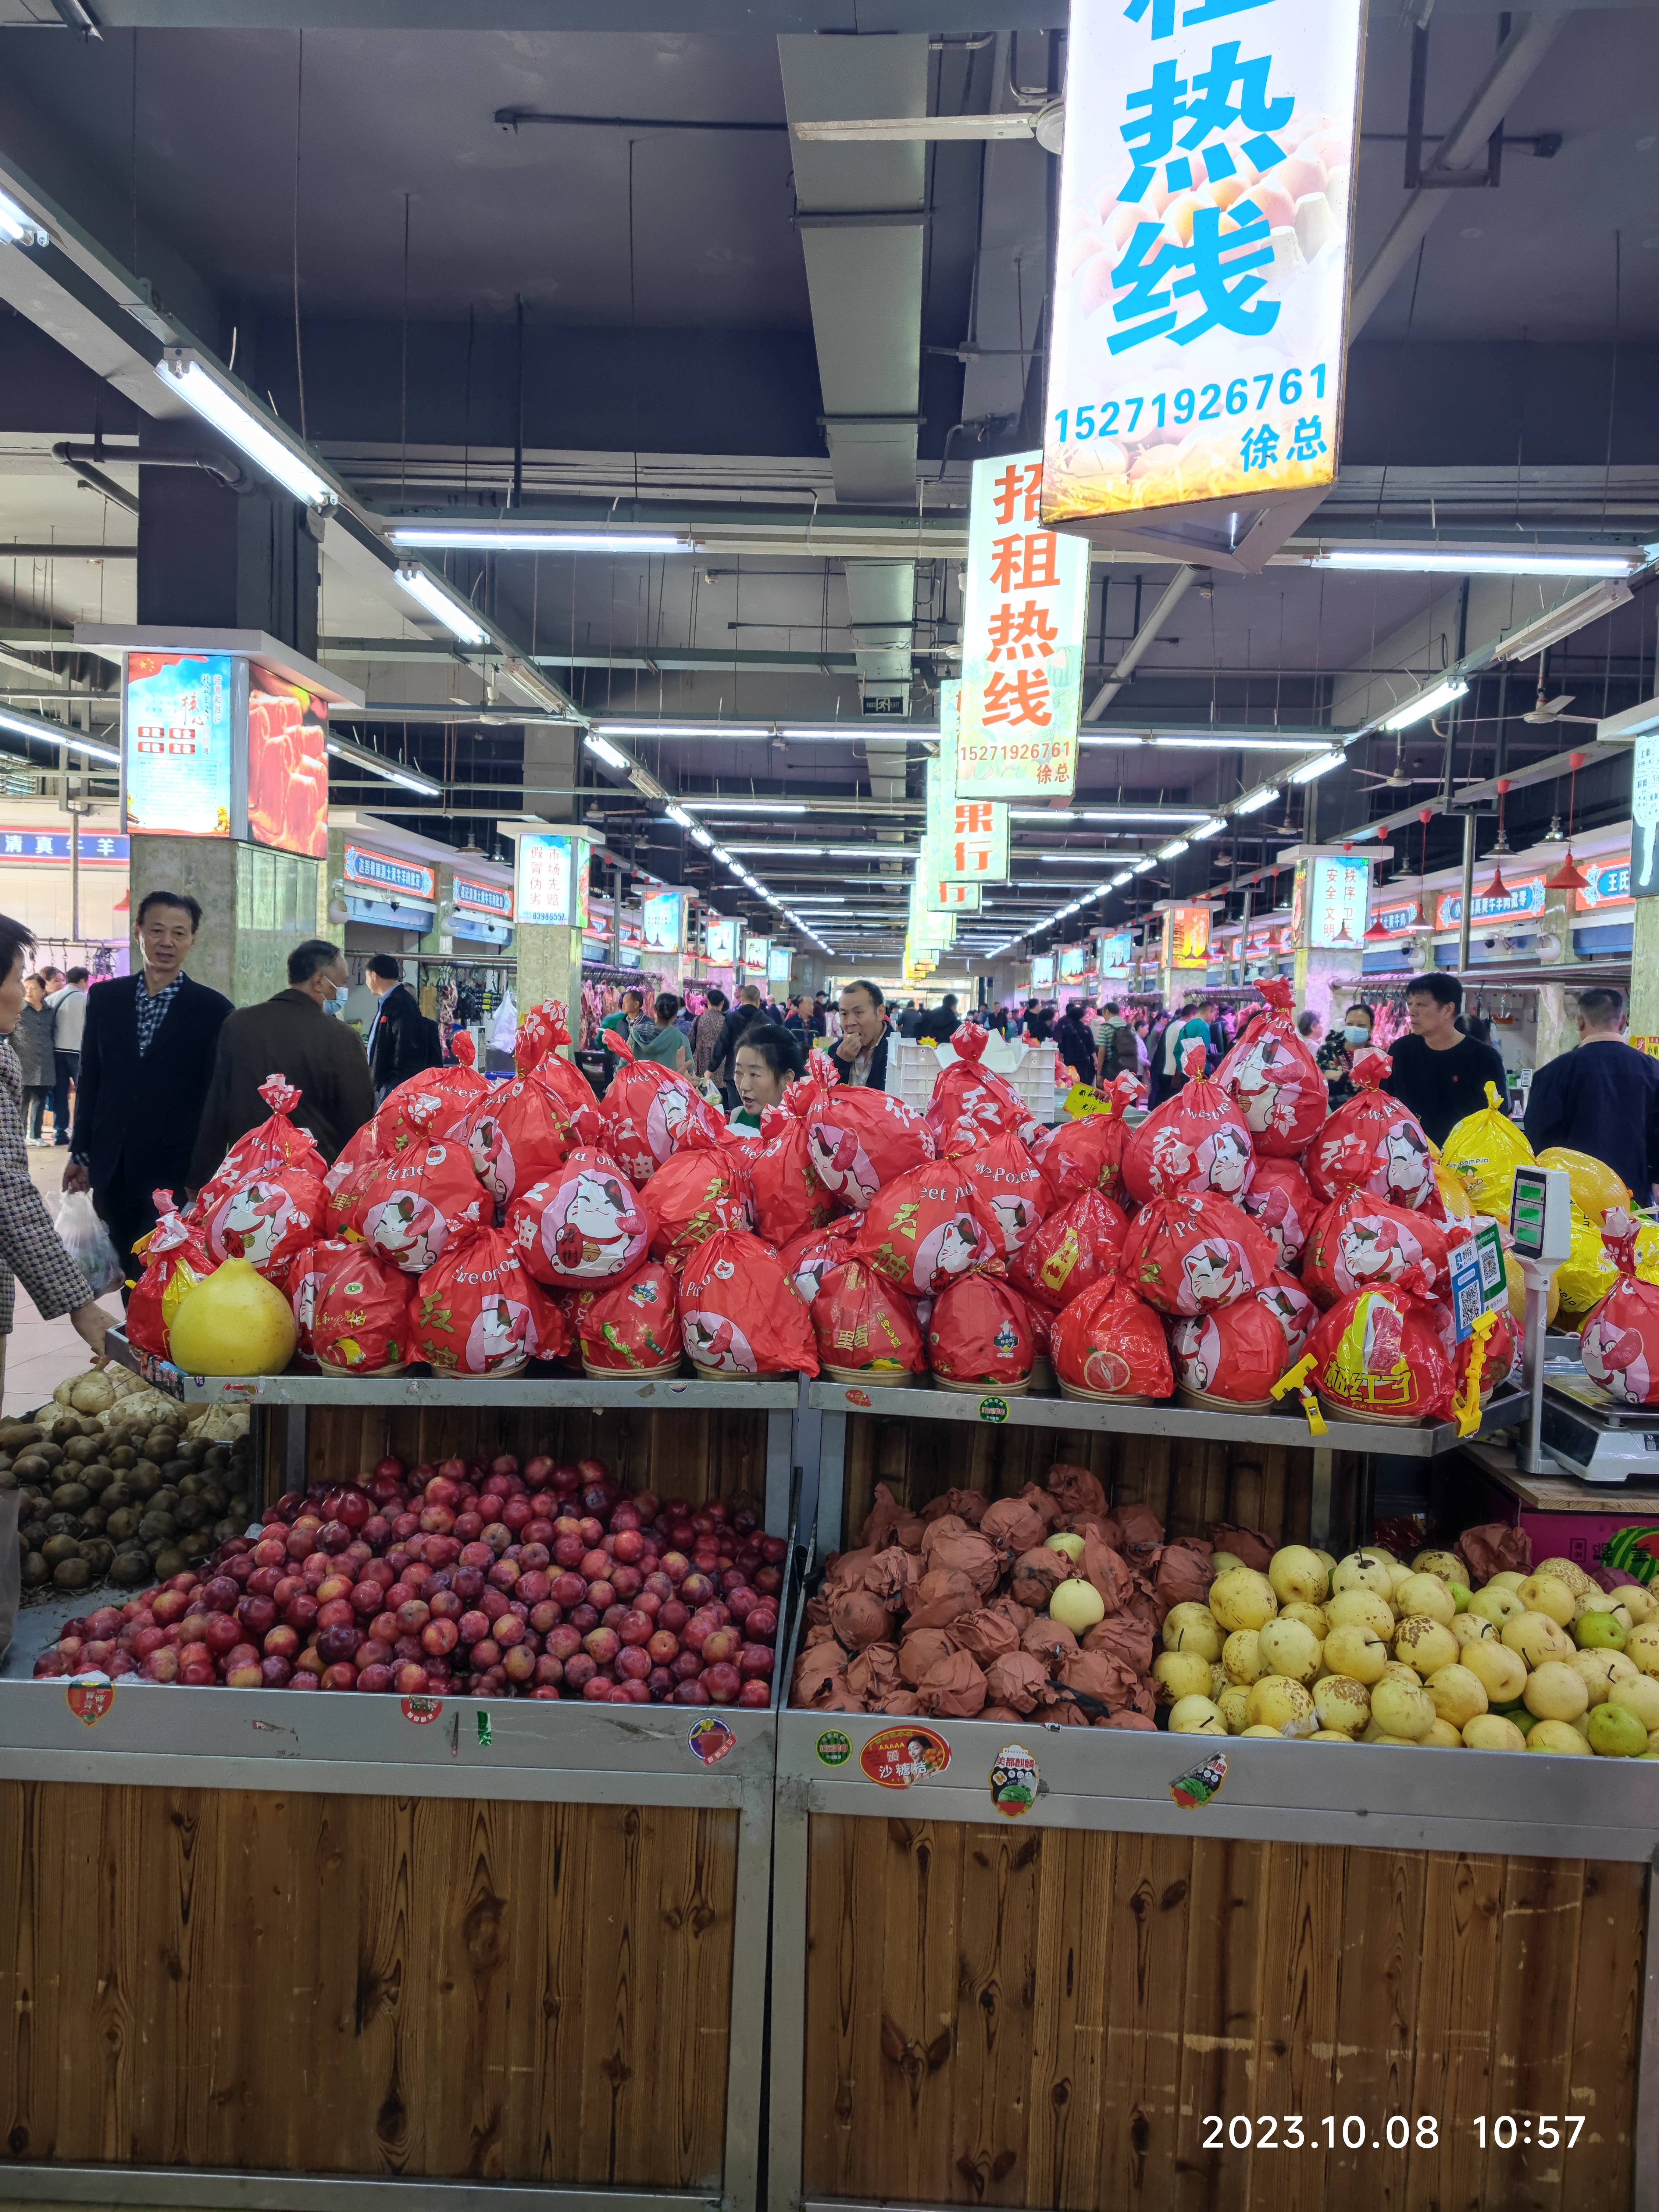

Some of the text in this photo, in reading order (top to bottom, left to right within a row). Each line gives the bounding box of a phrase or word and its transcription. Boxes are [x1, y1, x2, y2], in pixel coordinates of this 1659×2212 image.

[1106, 0, 1296, 356] 热线
[1056, 362, 1328, 443] 15271926761
[1240, 414, 1328, 473] 徐总
[981, 463, 1060, 728] 招租热线
[959, 741, 1071, 761] 15271926761
[1036, 763, 1071, 785] 徐总
[529, 846, 543, 905] 假冒伪劣
[547, 847, 560, 906] 市场先赔
[1608, 873, 1629, 892] 王氏
[533, 912, 564, 921] 83986557
[1324, 867, 1339, 938] 安全文明
[1459, 1157, 1489, 1166] pomelo
[1462, 1247, 1473, 1259] 支付宝
[876, 1312, 902, 1349] 小钟专营
[1324, 1360, 1412, 1404] 柚红了
[819, 1744, 848, 1752] 正宗美都
[879, 1742, 905, 1751] AAAAA
[878, 1761, 927, 1779] 沙糖桔
